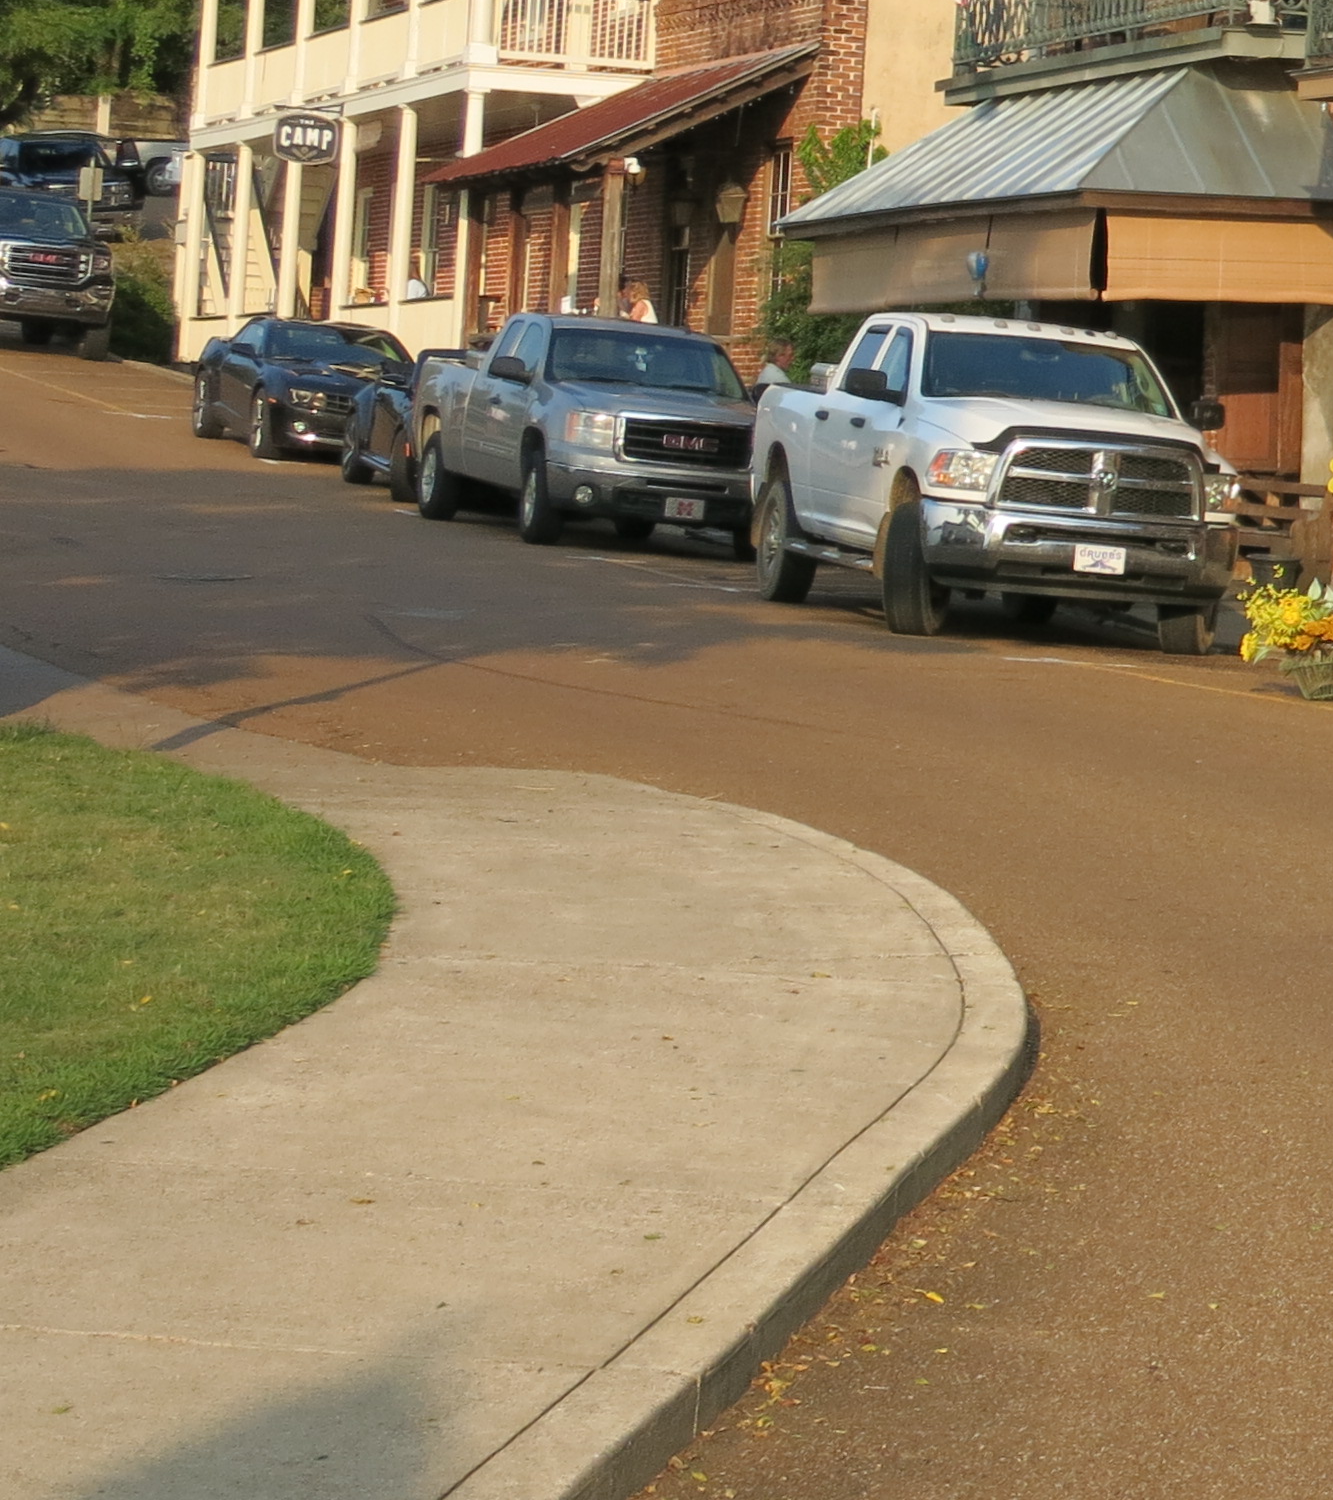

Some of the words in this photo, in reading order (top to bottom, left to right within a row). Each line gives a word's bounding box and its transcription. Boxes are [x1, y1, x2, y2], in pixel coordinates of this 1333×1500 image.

[299, 118, 315, 126] THE
[280, 124, 333, 151] CAMP
[663, 433, 719, 453] GMC
